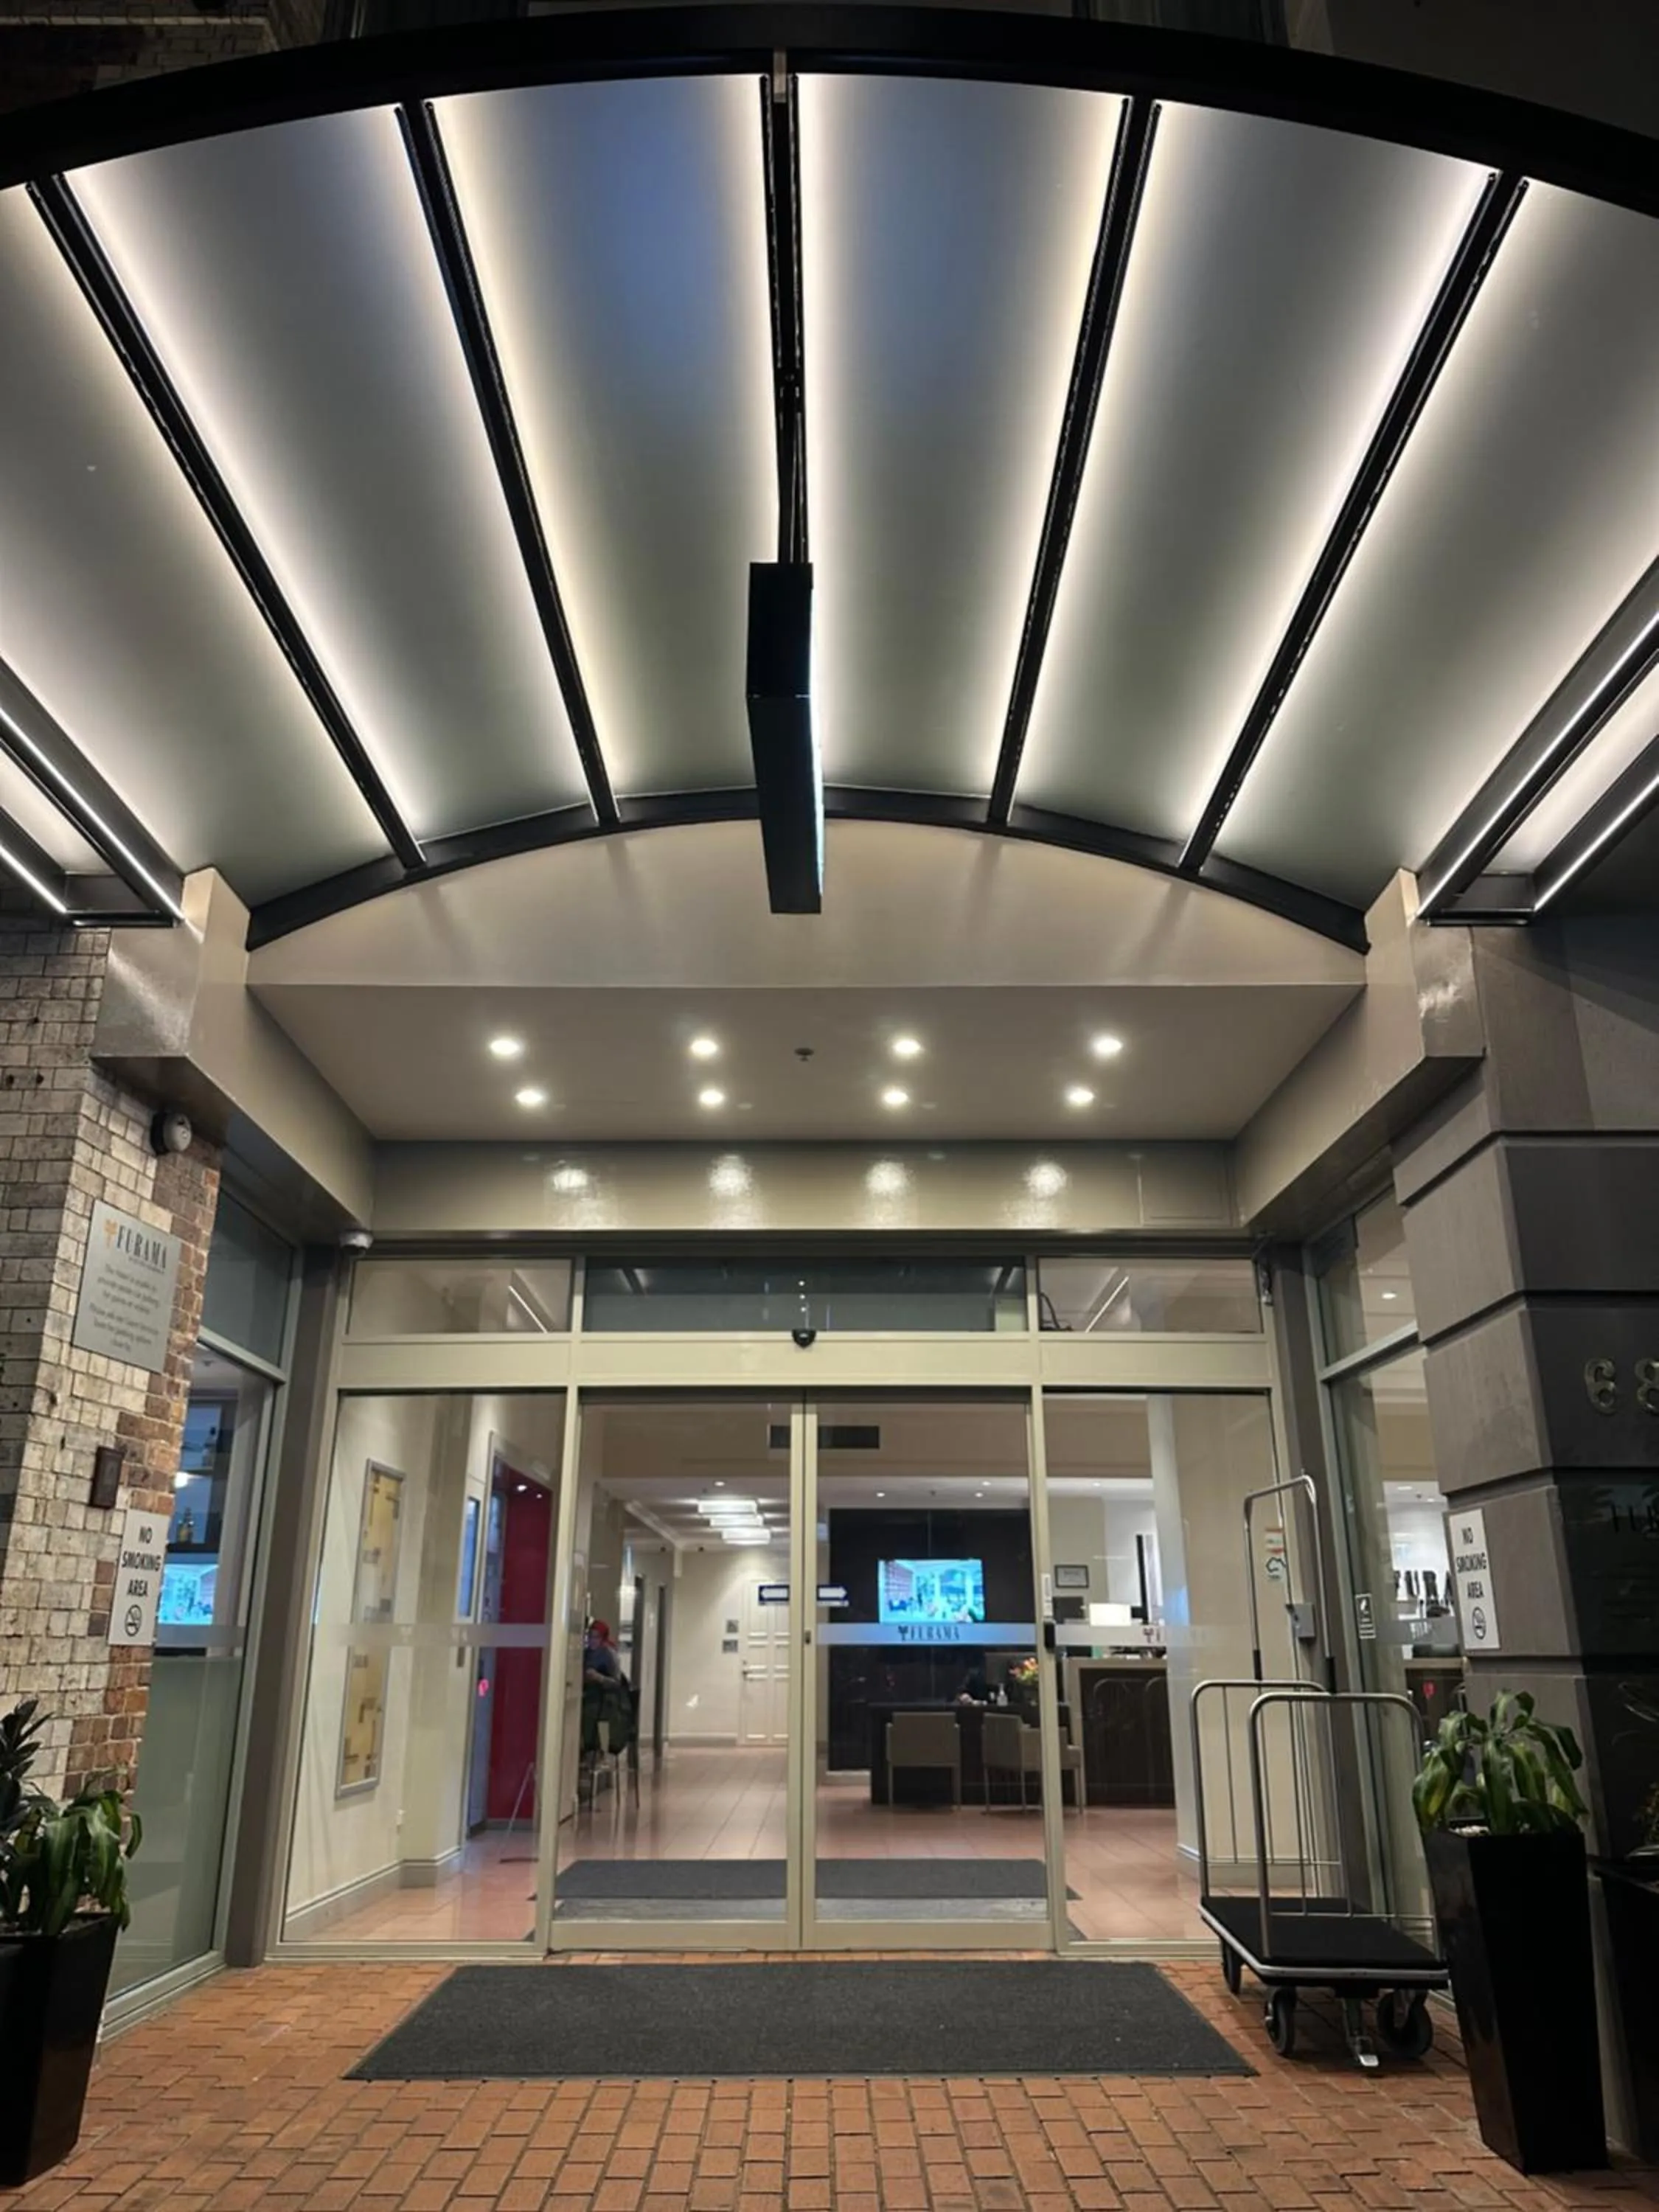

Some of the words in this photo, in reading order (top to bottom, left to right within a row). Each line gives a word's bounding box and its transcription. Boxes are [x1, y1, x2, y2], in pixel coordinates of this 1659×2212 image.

[116, 1225, 167, 1269] FURAMA
[138, 1526, 153, 1544] NO
[1461, 1526, 1474, 1545] NO
[121, 1551, 161, 1572] SMOKING
[1455, 1551, 1487, 1574] SMOKING
[126, 1579, 148, 1597] AREA
[1467, 1580, 1484, 1599] AREA
